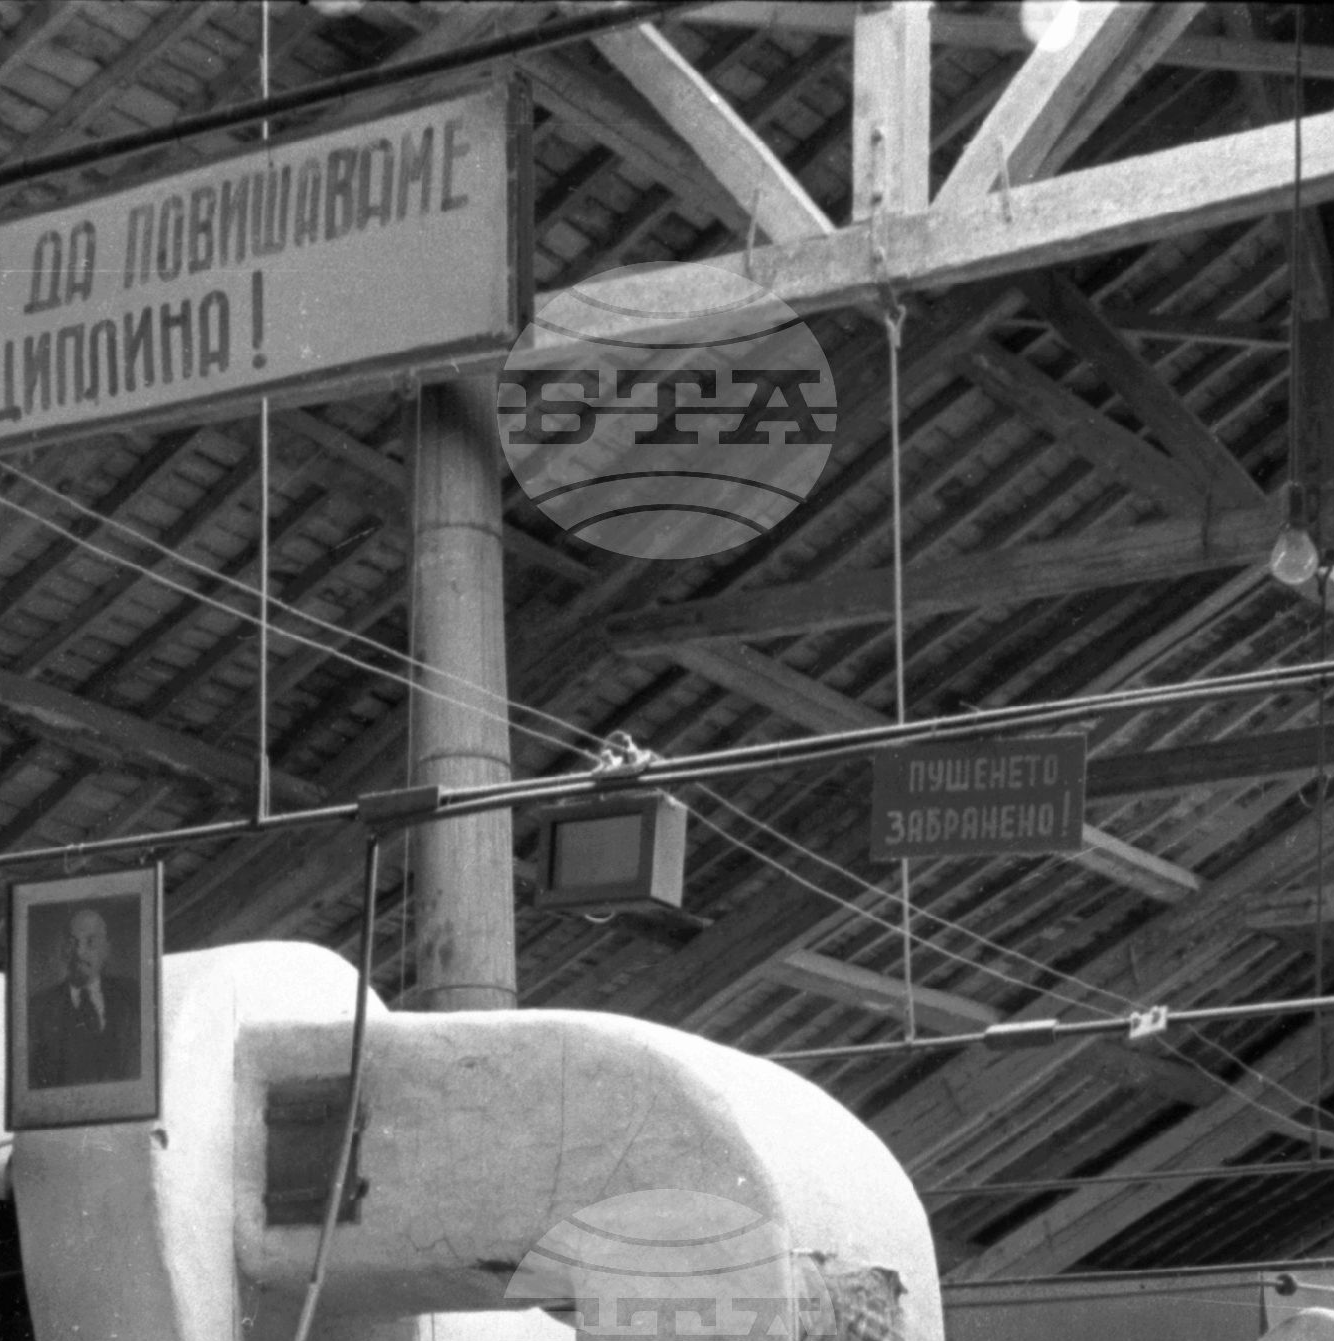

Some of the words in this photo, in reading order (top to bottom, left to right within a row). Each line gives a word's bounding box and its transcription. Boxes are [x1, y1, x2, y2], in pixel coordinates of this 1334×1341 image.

[24, 218, 96, 315] ДА
[123, 115, 471, 290] ПОВИШАВАМЕ
[909, 754, 1059, 793] ПУШЕНЕТО
